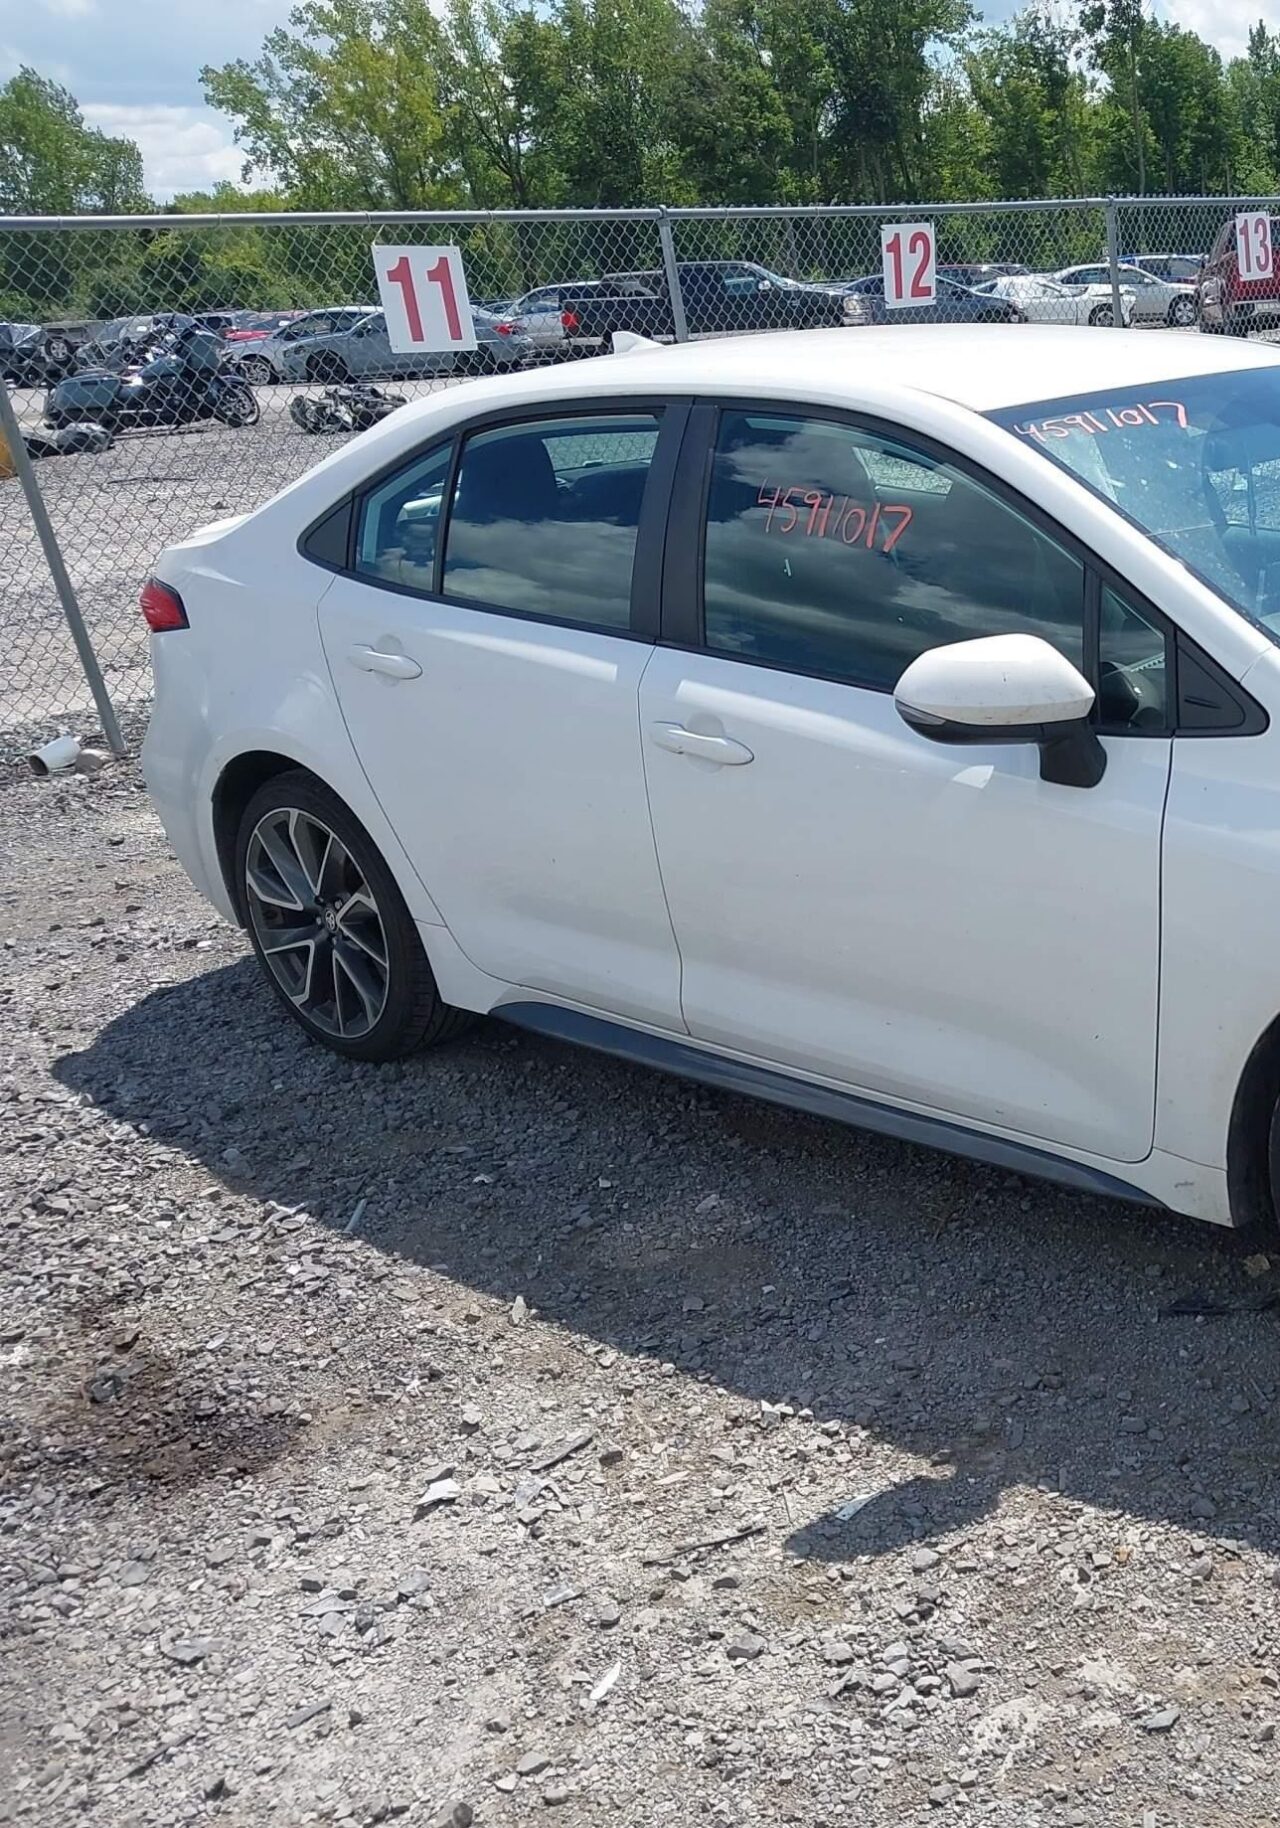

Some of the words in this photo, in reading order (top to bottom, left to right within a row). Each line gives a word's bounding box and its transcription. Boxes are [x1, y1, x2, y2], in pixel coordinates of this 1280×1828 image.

[885, 231, 932, 300] 12
[1239, 217, 1270, 273] 13
[386, 256, 463, 342] 11
[1013, 402, 1188, 442] 45911017
[757, 477, 913, 553] 45911017
